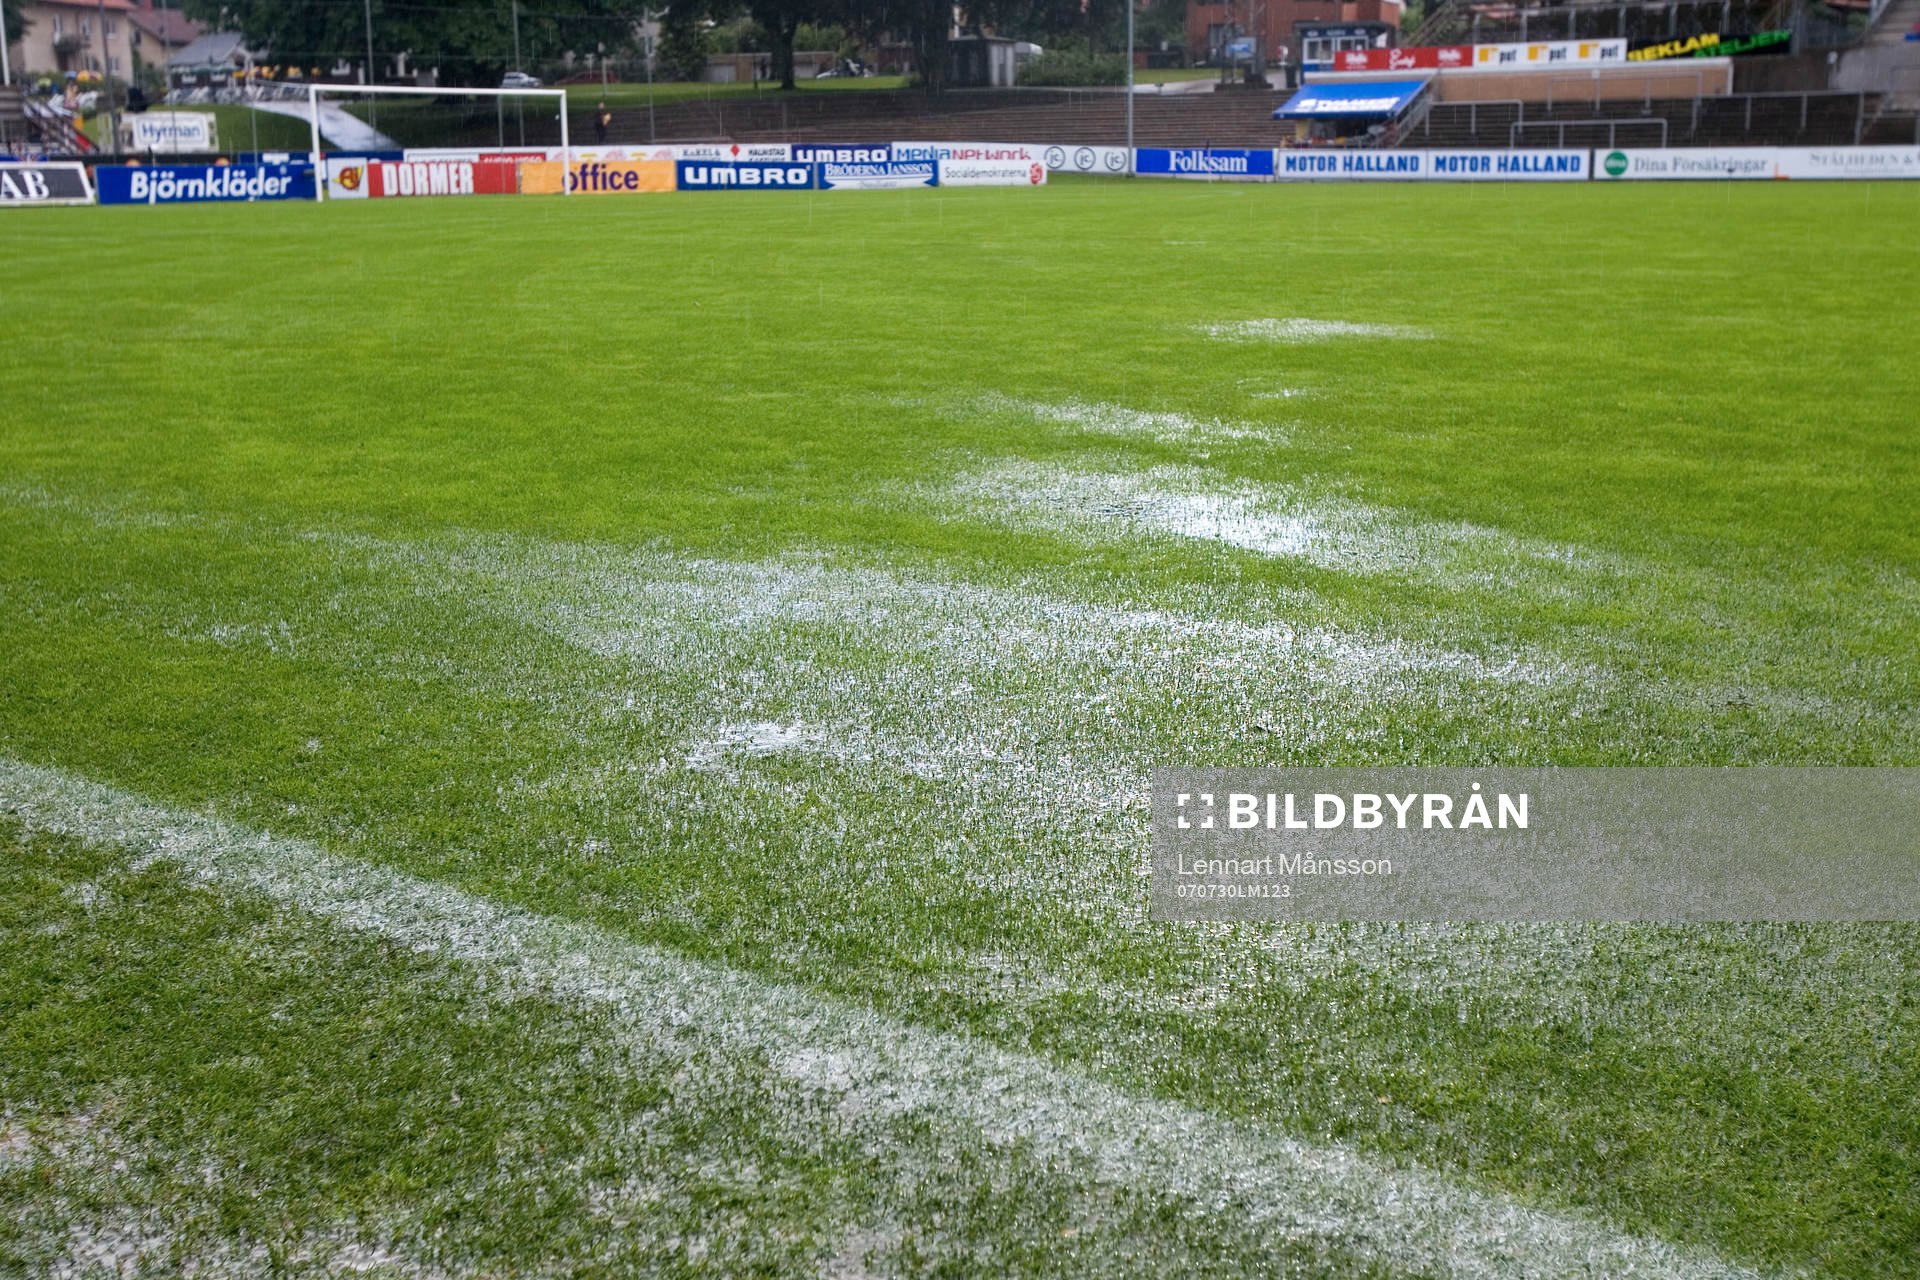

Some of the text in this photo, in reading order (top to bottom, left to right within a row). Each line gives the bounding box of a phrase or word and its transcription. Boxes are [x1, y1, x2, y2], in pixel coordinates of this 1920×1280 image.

[796, 148, 887, 162] UMBRO
[1168, 150, 1247, 173] Folksam
[1286, 155, 1419, 172] MOTOR HALLAND
[1434, 155, 1581, 172] MOTOR HALLAND
[944, 166, 1027, 179] Socialdemokraterna
[1634, 156, 1768, 174] Dina Försäkringar
[0, 170, 49, 198] AB
[381, 162, 474, 196] DORMER
[562, 163, 639, 191] office
[684, 166, 808, 185] UMBRO
[131, 166, 292, 205] Björnkläder
